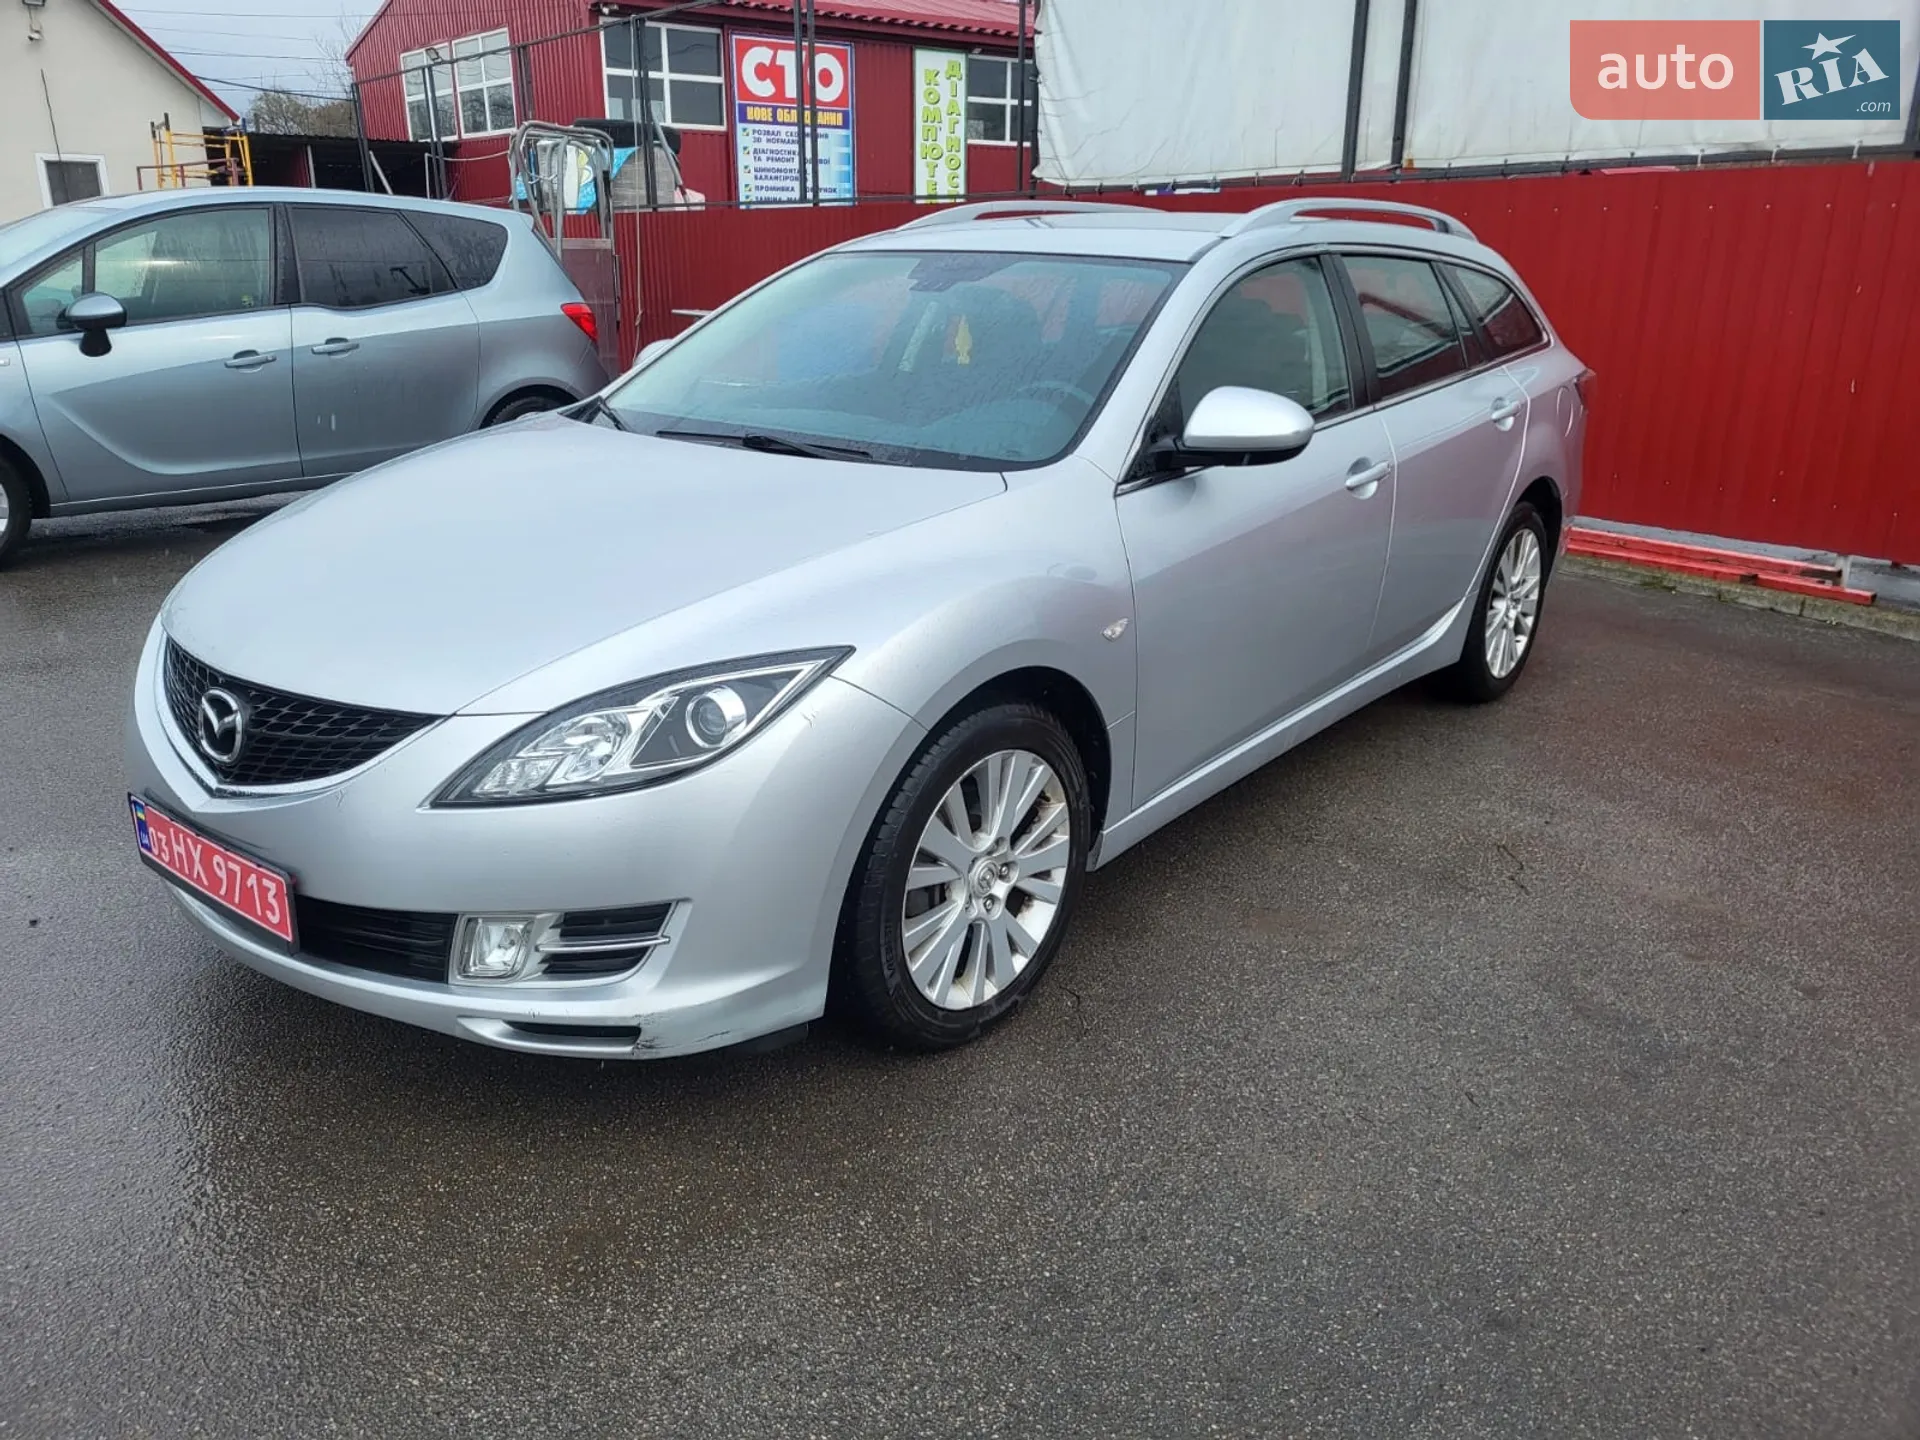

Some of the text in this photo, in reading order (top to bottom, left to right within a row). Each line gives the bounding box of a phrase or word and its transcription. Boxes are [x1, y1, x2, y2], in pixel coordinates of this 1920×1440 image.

[742, 46, 844, 102] СТО
[746, 106, 773, 122] НОВЕ
[752, 129, 781, 137] РОЗВАЛ
[920, 68, 944, 204] КОМП'ЮТЕ
[753, 147, 800, 156] ДІАГНОСТИК
[212, 854, 281, 924] 9713
